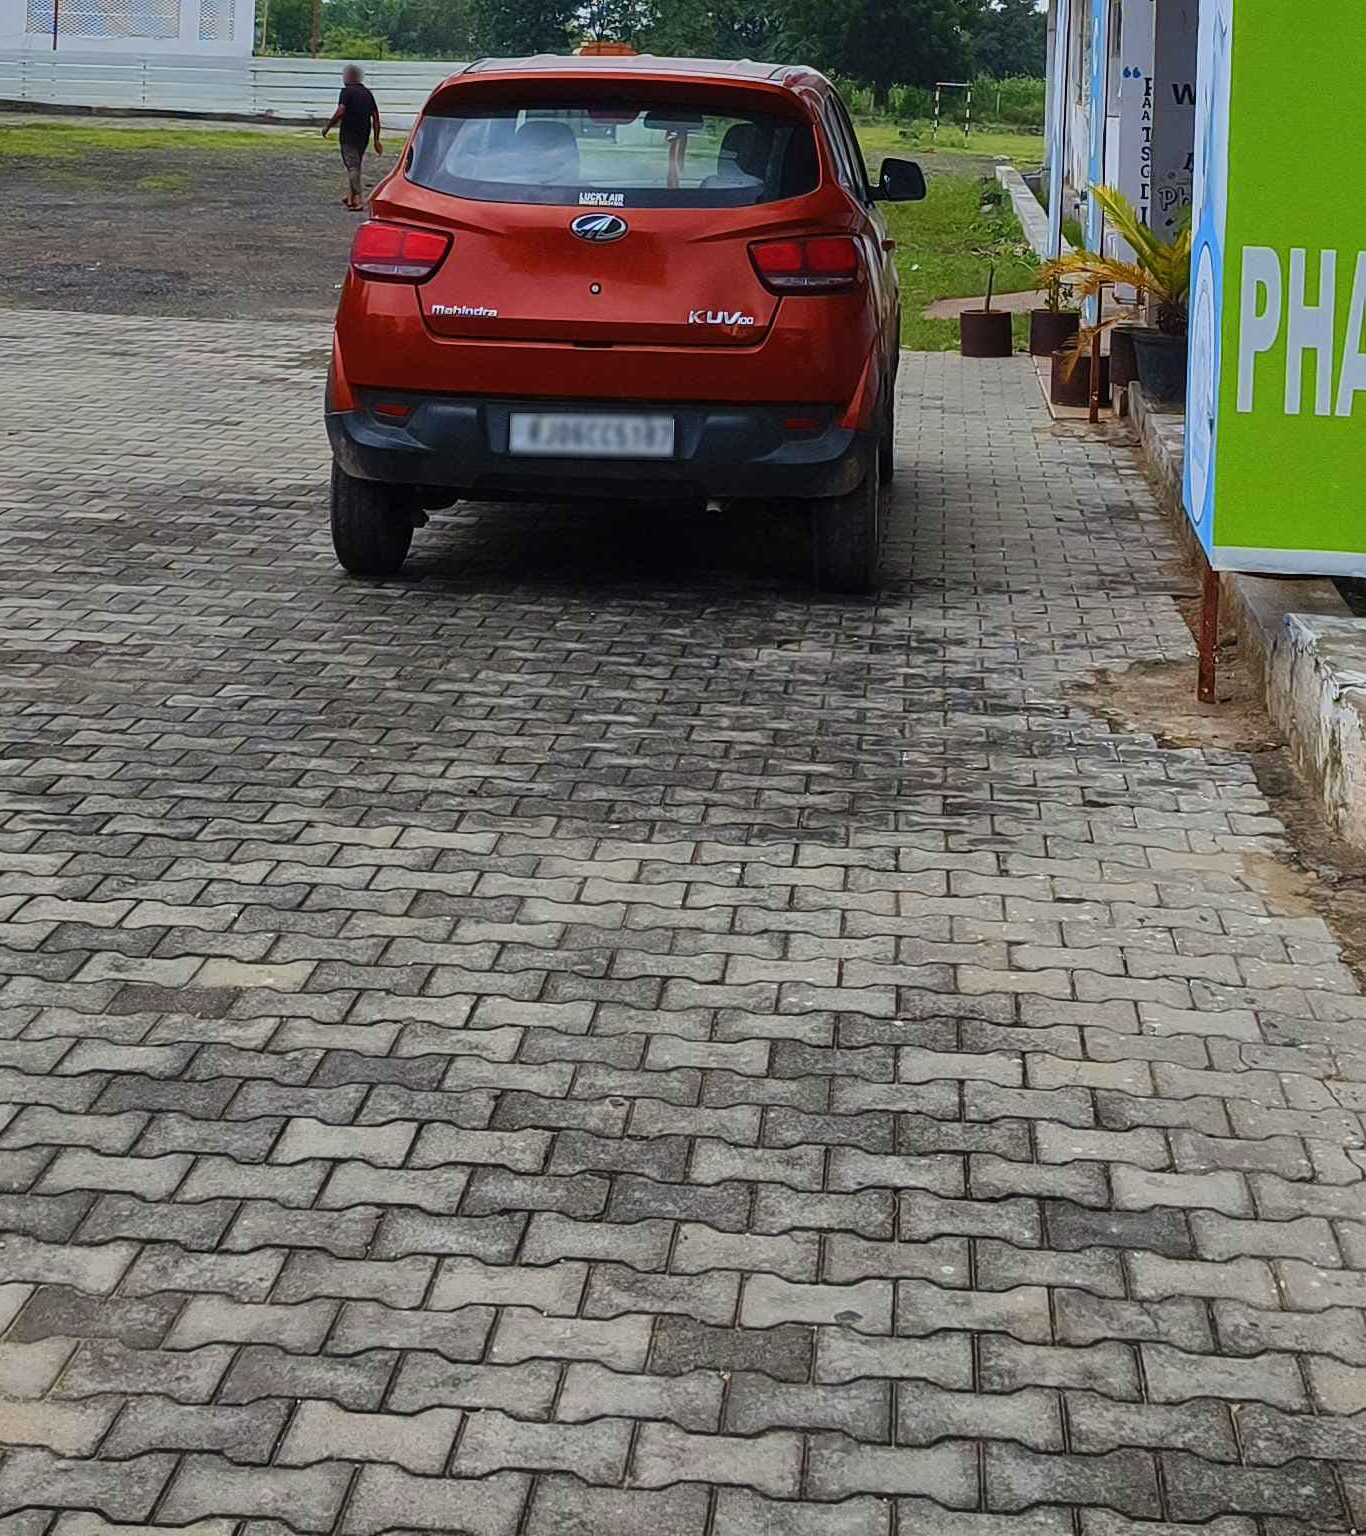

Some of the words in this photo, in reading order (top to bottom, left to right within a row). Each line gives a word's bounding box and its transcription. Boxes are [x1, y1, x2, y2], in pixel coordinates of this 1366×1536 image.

[578, 192, 608, 201] LUCKY
[608, 193, 624, 202] AIR
[431, 304, 499, 318] Mahindra
